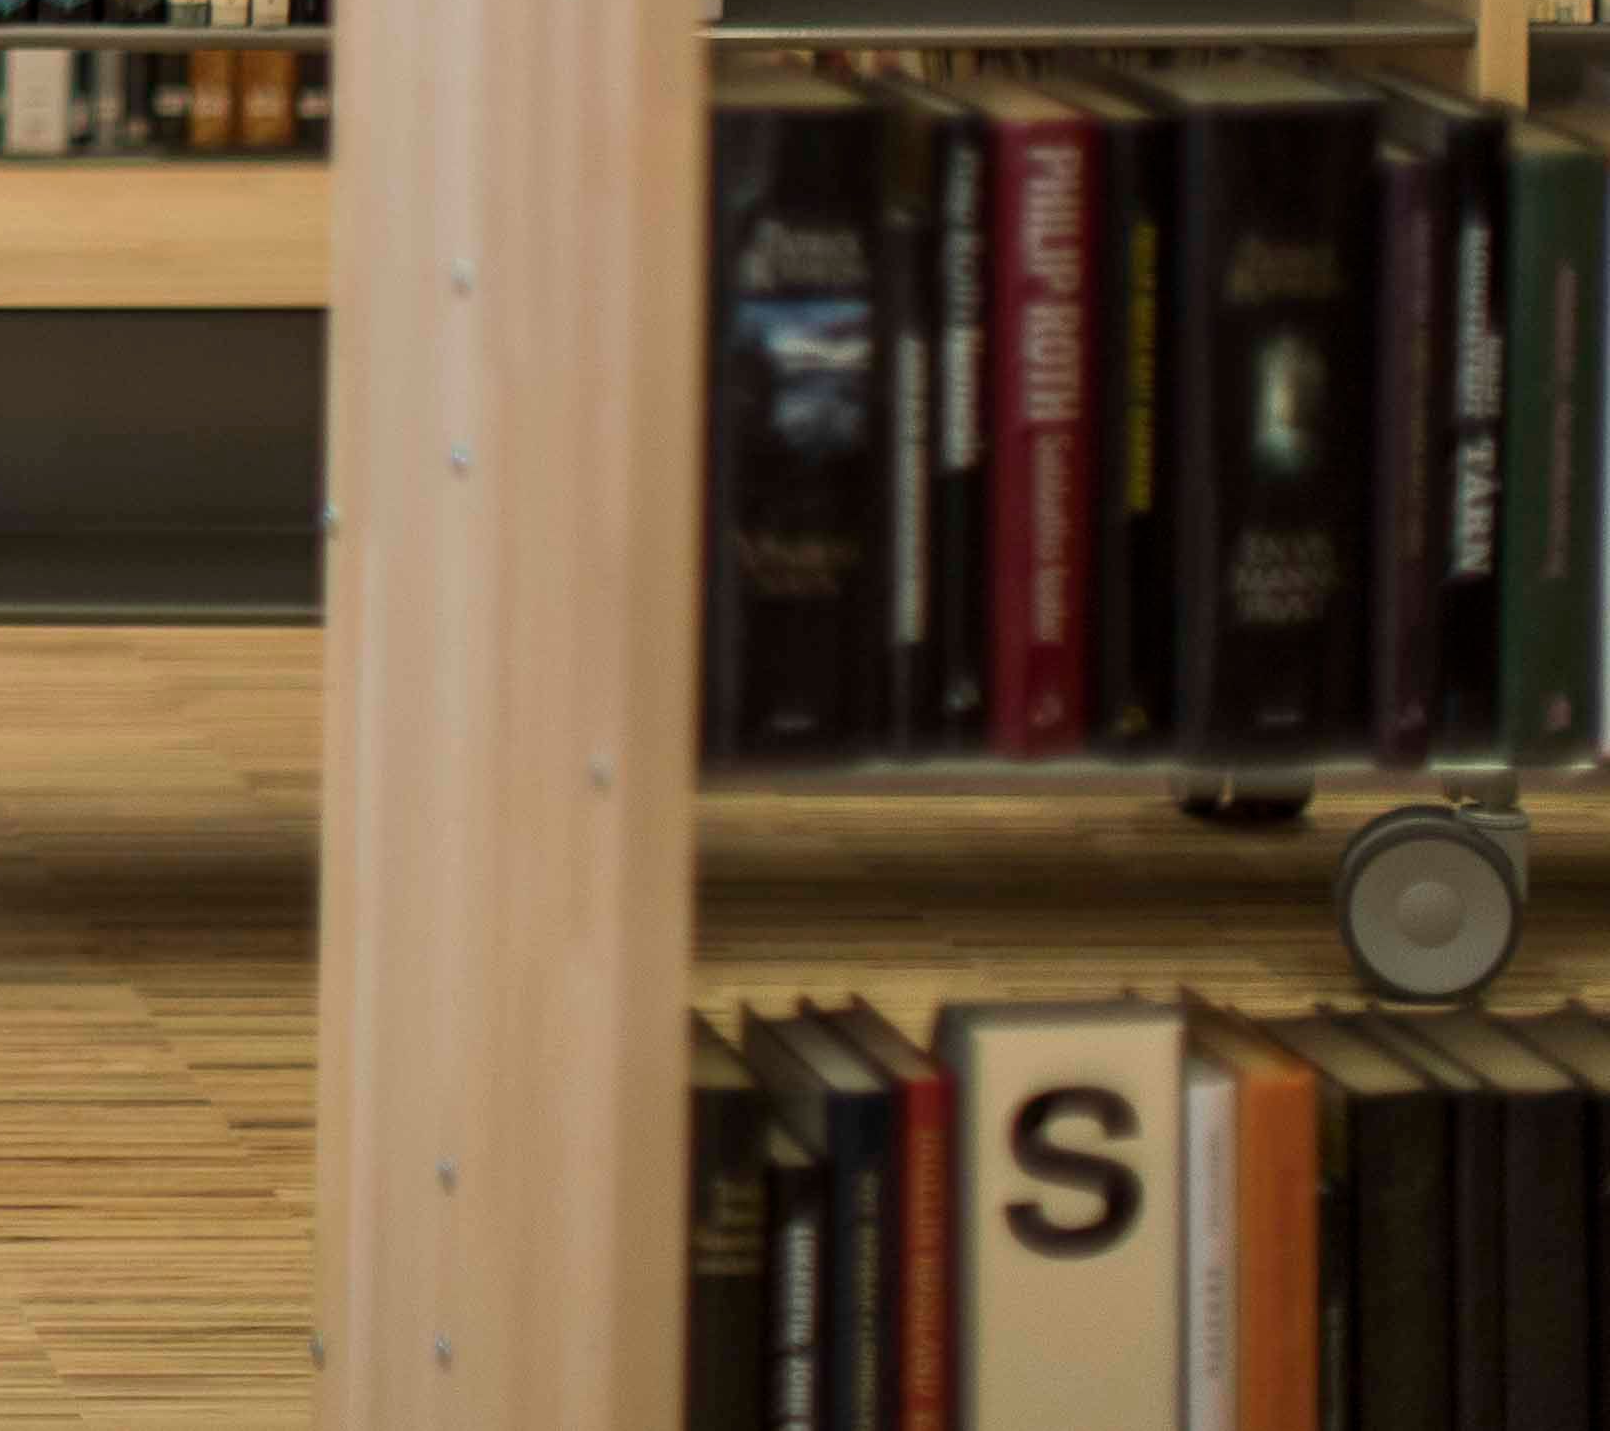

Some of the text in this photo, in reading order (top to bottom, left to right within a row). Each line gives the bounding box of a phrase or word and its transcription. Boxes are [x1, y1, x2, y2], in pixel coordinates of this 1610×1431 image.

[1024, 147, 1082, 294] PHILIP
[1024, 301, 1082, 421] ROTH
[1005, 1085, 1146, 1261] S
